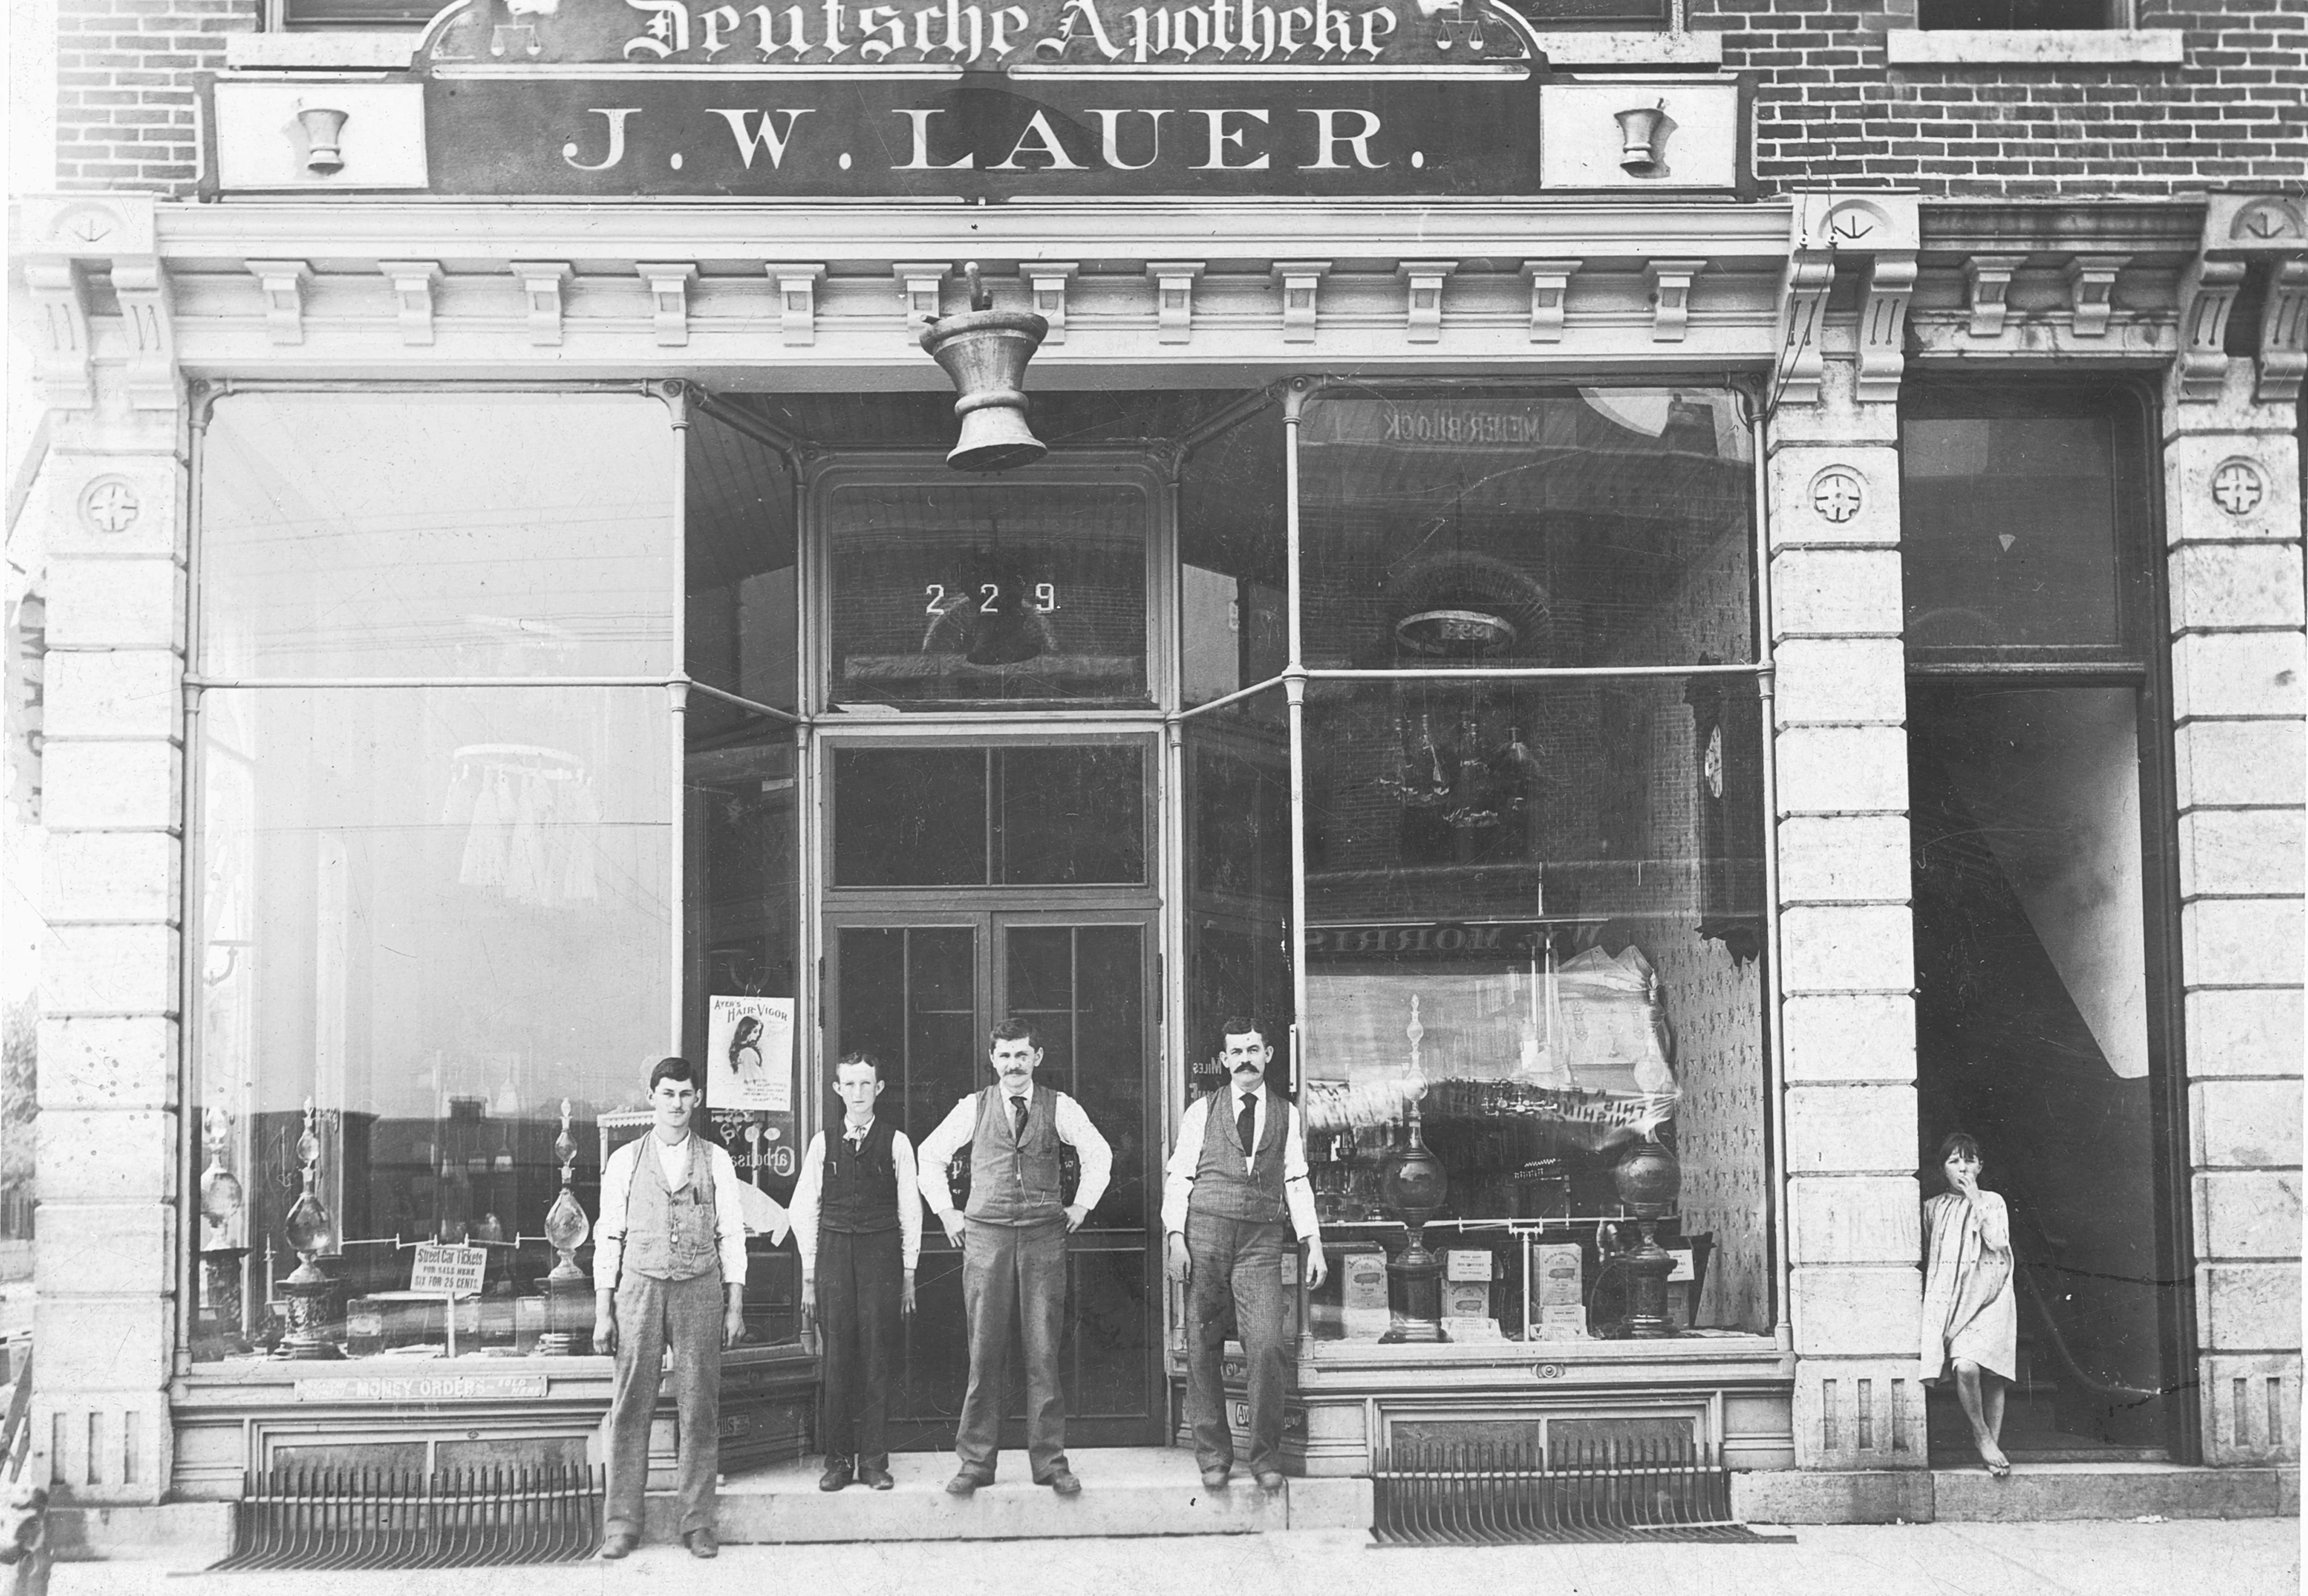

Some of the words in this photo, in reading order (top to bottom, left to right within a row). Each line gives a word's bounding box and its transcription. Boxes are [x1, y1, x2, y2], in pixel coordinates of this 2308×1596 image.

[623, 0, 1029, 63] Deutsche
[1035, 0, 1396, 63] Apotheke
[714, 999, 741, 1011] AYER'S
[417, 1248, 440, 1263] Street
[442, 1249, 454, 1264] Car
[457, 1267, 475, 1276] HERE
[414, 1275, 425, 1286] SIX
[429, 1276, 442, 1288] FOR
[445, 1277, 454, 1289] 25
[357, 1379, 413, 1398] MONEY
[419, 1377, 486, 1396] ORDERS
